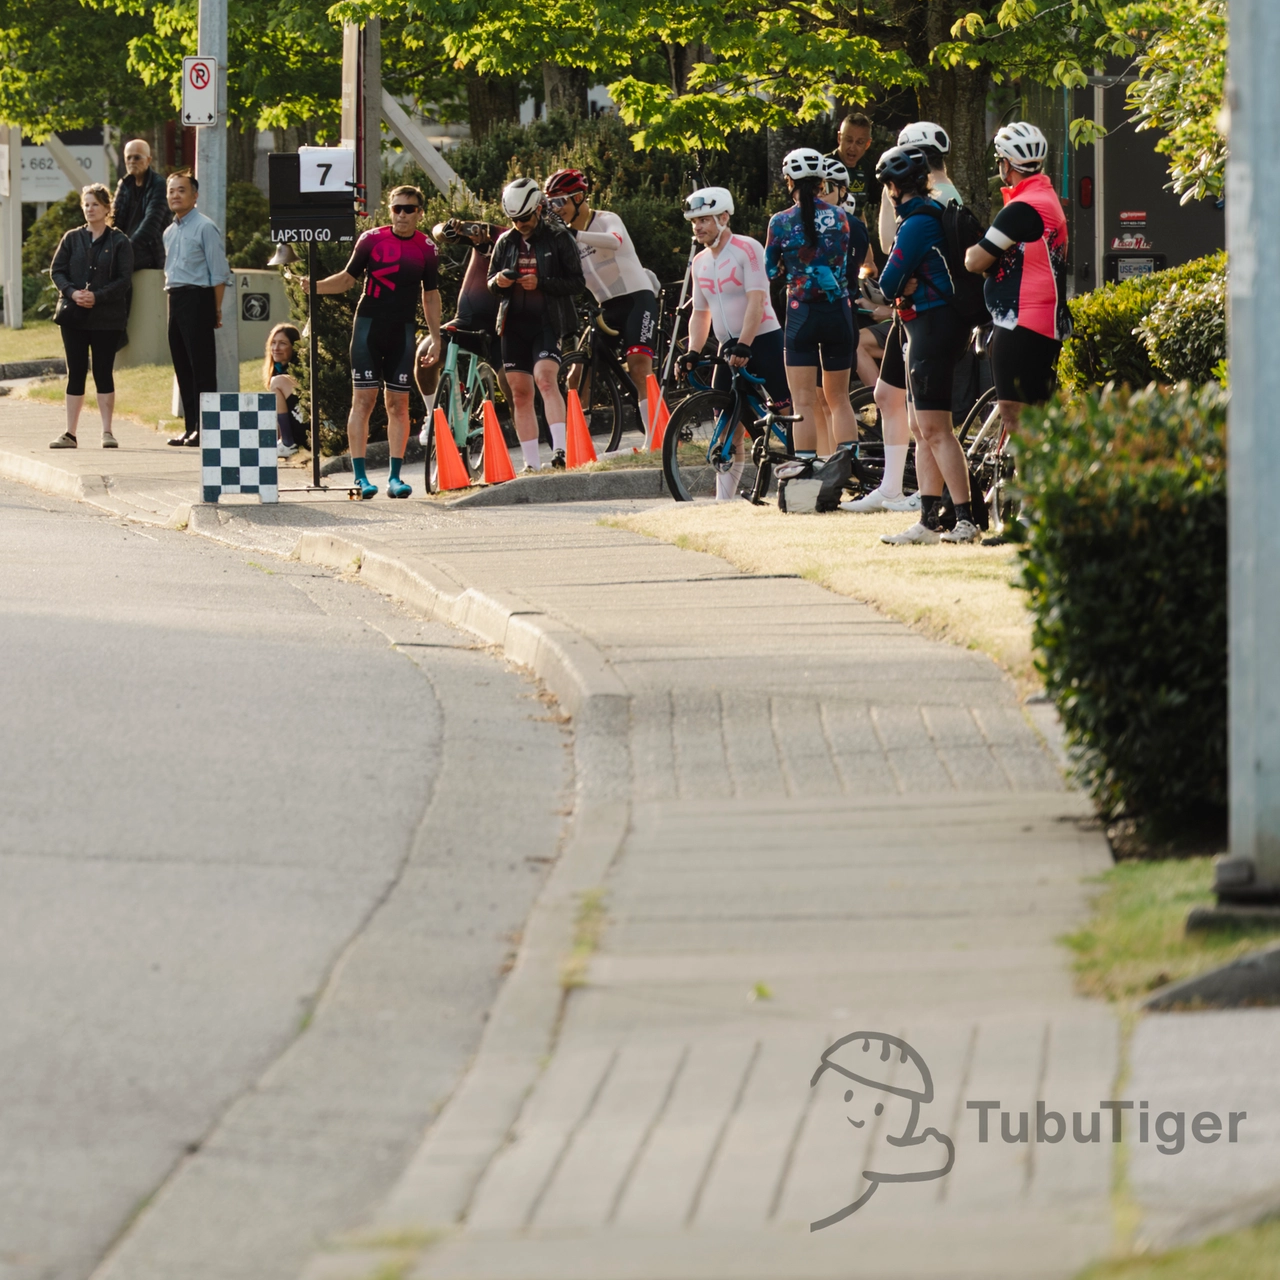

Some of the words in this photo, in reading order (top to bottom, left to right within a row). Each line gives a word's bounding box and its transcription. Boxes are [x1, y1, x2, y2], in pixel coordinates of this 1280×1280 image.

[30, 158, 54, 170] 662
[316, 163, 333, 186] 7
[271, 229, 298, 242] LAPS
[299, 229, 313, 241] TO
[314, 228, 331, 241] GO
[241, 276, 249, 288] A
